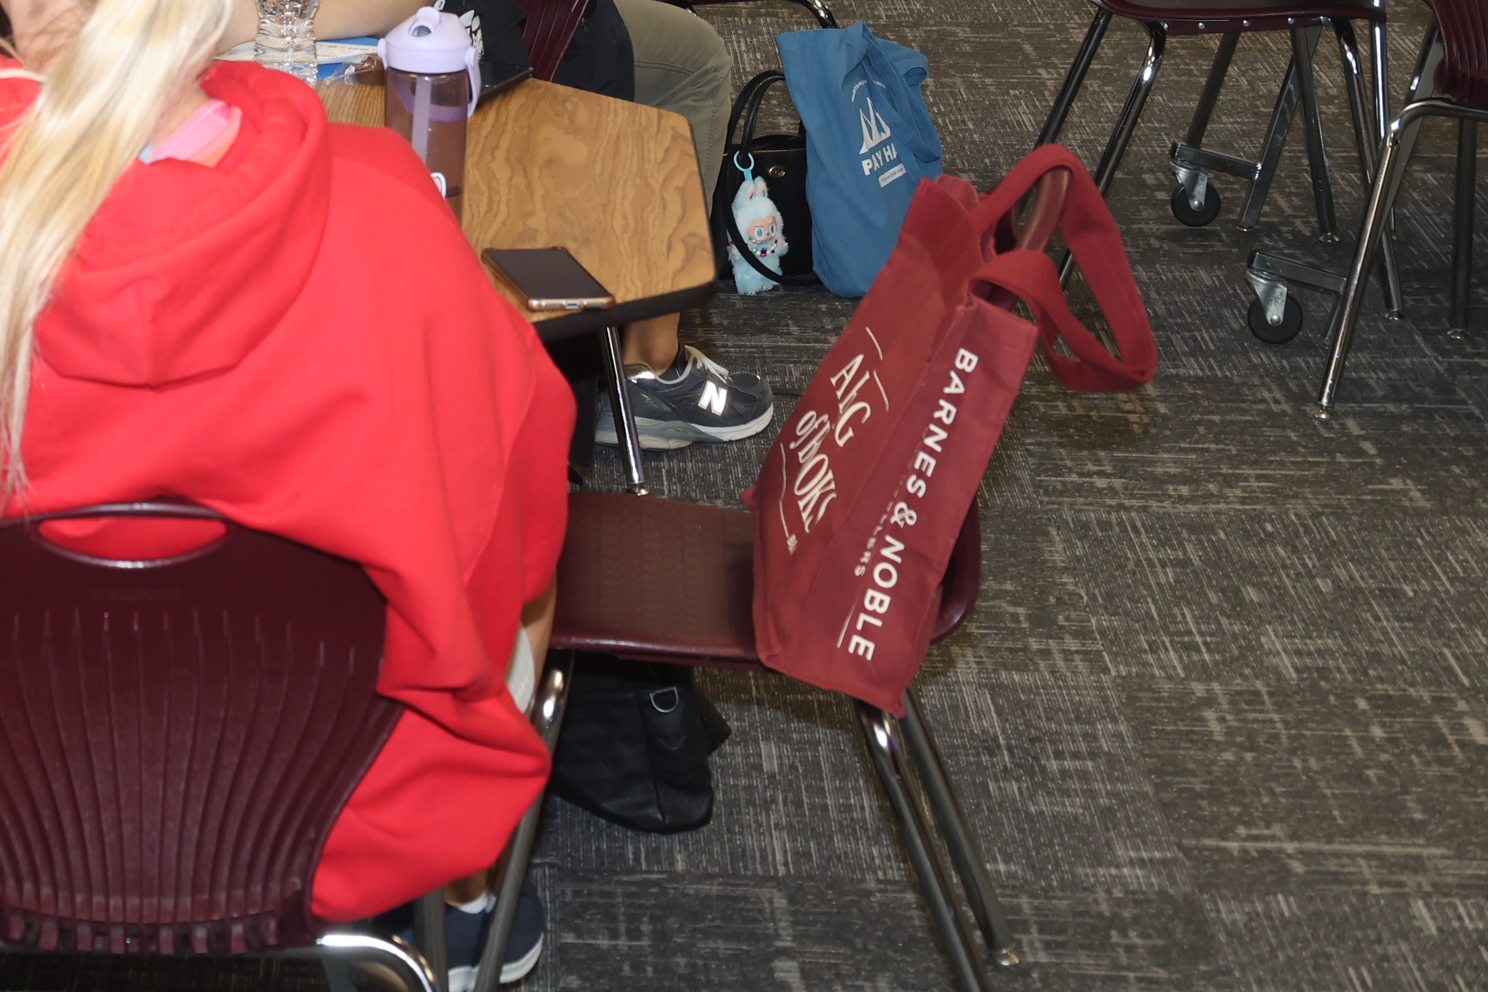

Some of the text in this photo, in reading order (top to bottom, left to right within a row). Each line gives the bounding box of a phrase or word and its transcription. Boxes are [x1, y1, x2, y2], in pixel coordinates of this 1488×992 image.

[698, 379, 728, 416] N
[906, 347, 979, 499] BARNES
[890, 501, 918, 529] &
[847, 534, 906, 661] NOBLE
